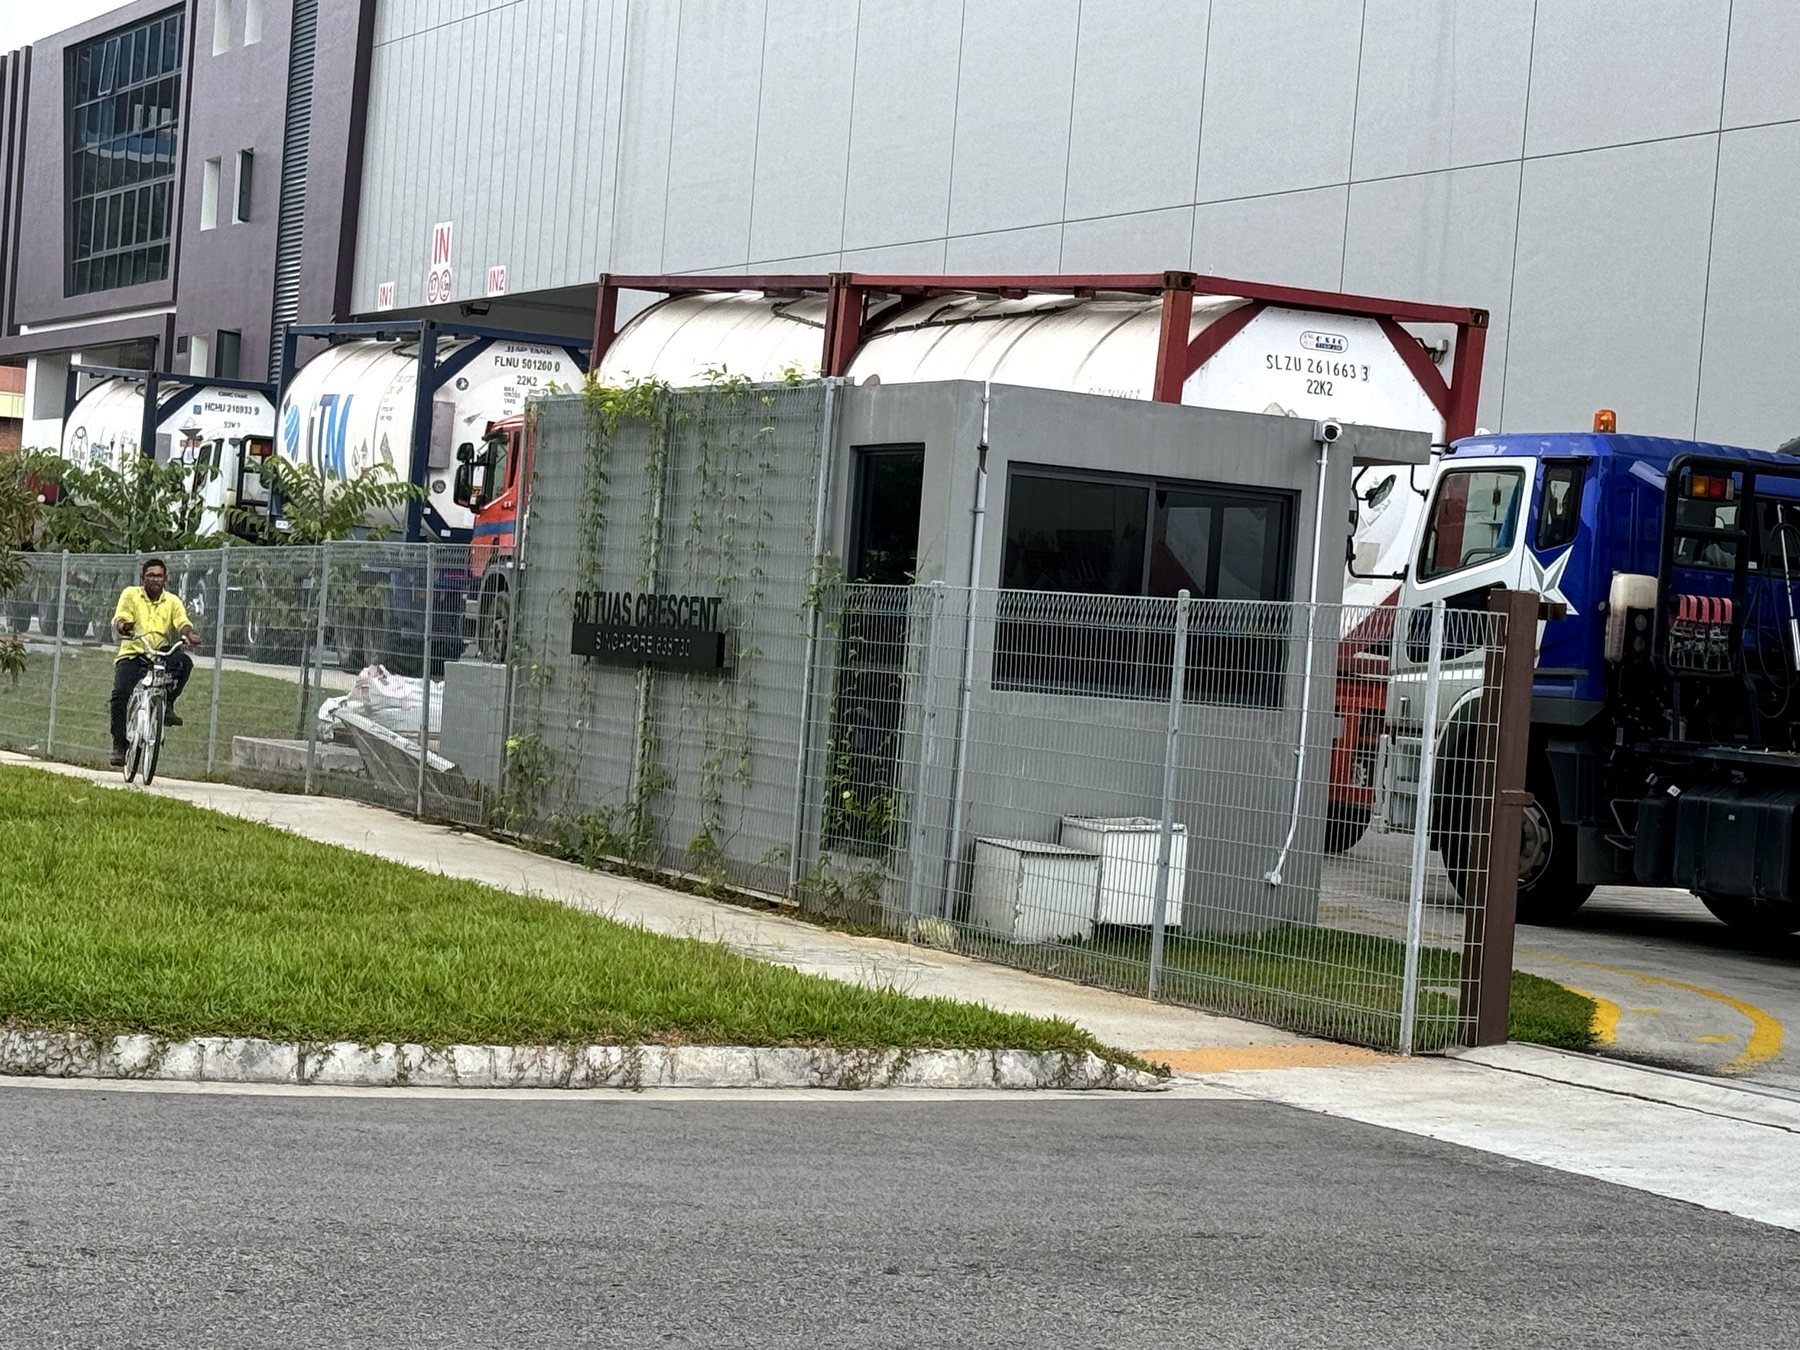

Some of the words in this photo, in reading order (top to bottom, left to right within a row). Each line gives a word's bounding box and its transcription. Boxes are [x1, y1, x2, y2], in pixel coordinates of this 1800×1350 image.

[433, 226, 451, 265] IN
[488, 269, 505, 293] IN2
[379, 285, 394, 307] IN1
[494, 355, 519, 369] FLNU
[521, 358, 553, 372] 501260
[554, 361, 561, 373] 0
[1266, 354, 1302, 372] SLZU
[1306, 358, 1357, 379] 261663
[1361, 365, 1370, 382] 3
[516, 375, 538, 387] 22K2
[1306, 379, 1334, 396] 22K2
[574, 591, 590, 622] 50
[593, 591, 632, 626] TUAS
[634, 593, 722, 632] CRESCENT
[595, 631, 653, 654] SINGAPORE
